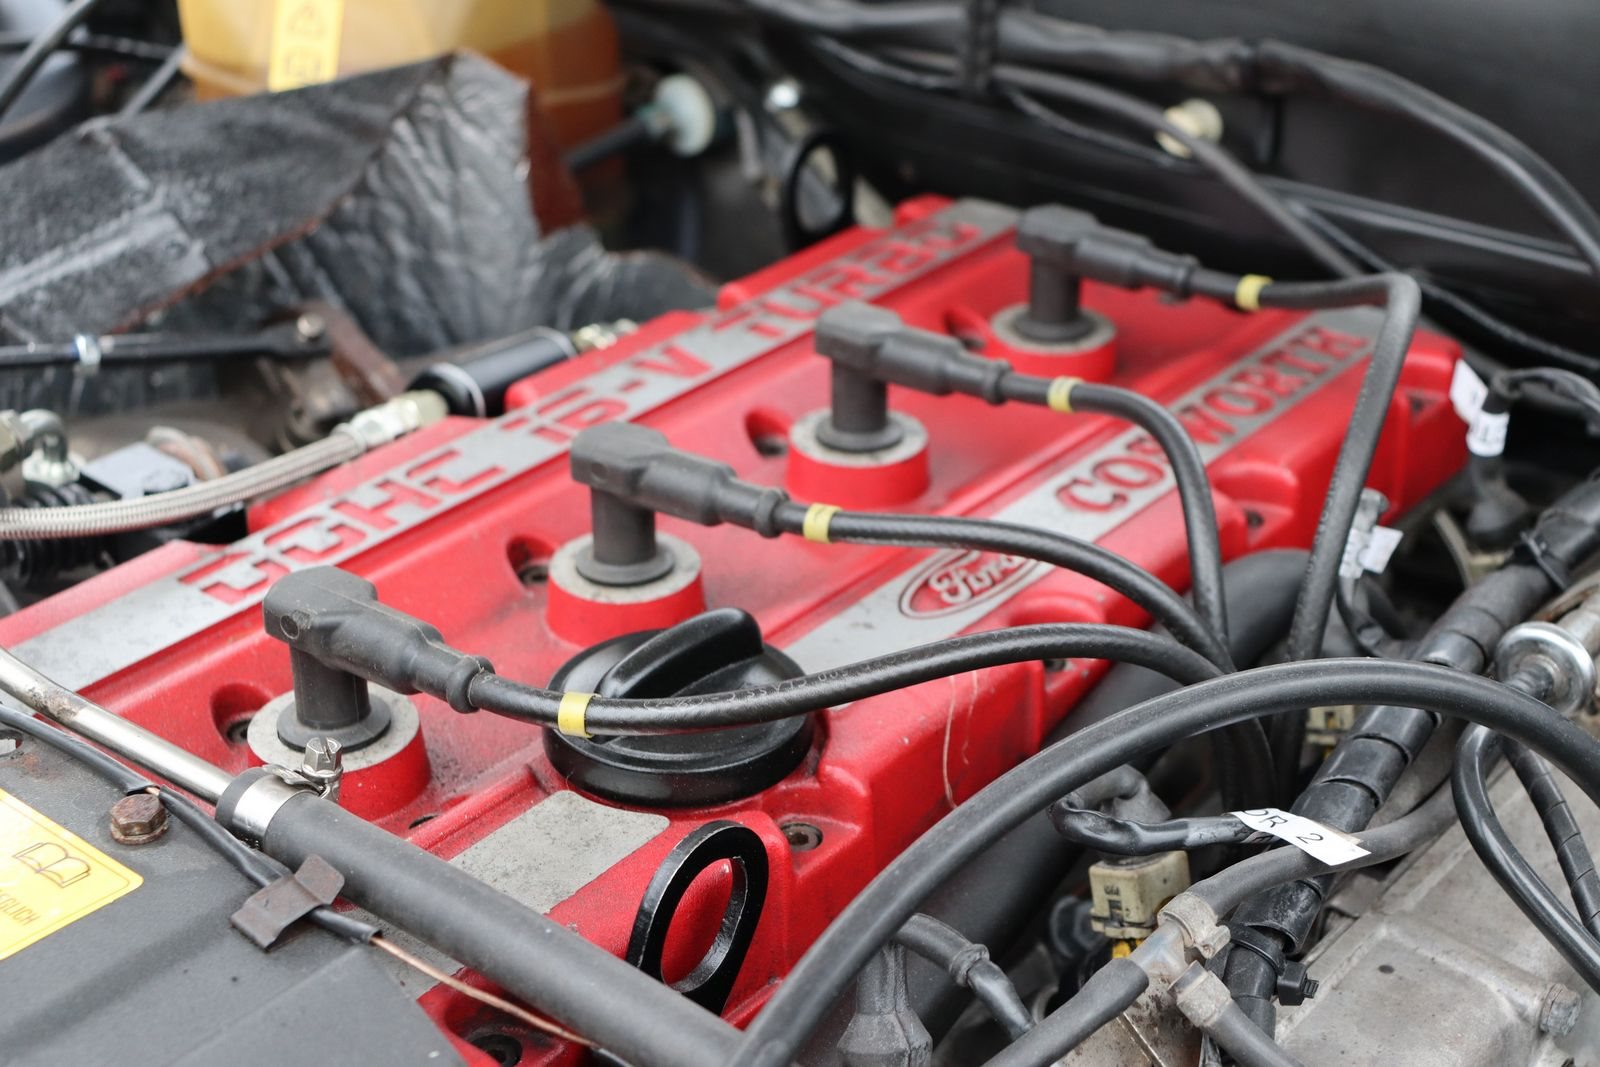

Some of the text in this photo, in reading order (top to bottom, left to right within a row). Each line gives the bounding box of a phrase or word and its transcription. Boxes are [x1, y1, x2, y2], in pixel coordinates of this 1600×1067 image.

[178, 450, 504, 606] DOHC
[711, 221, 984, 338] TURBO
[1296, 832, 1325, 845] 2
